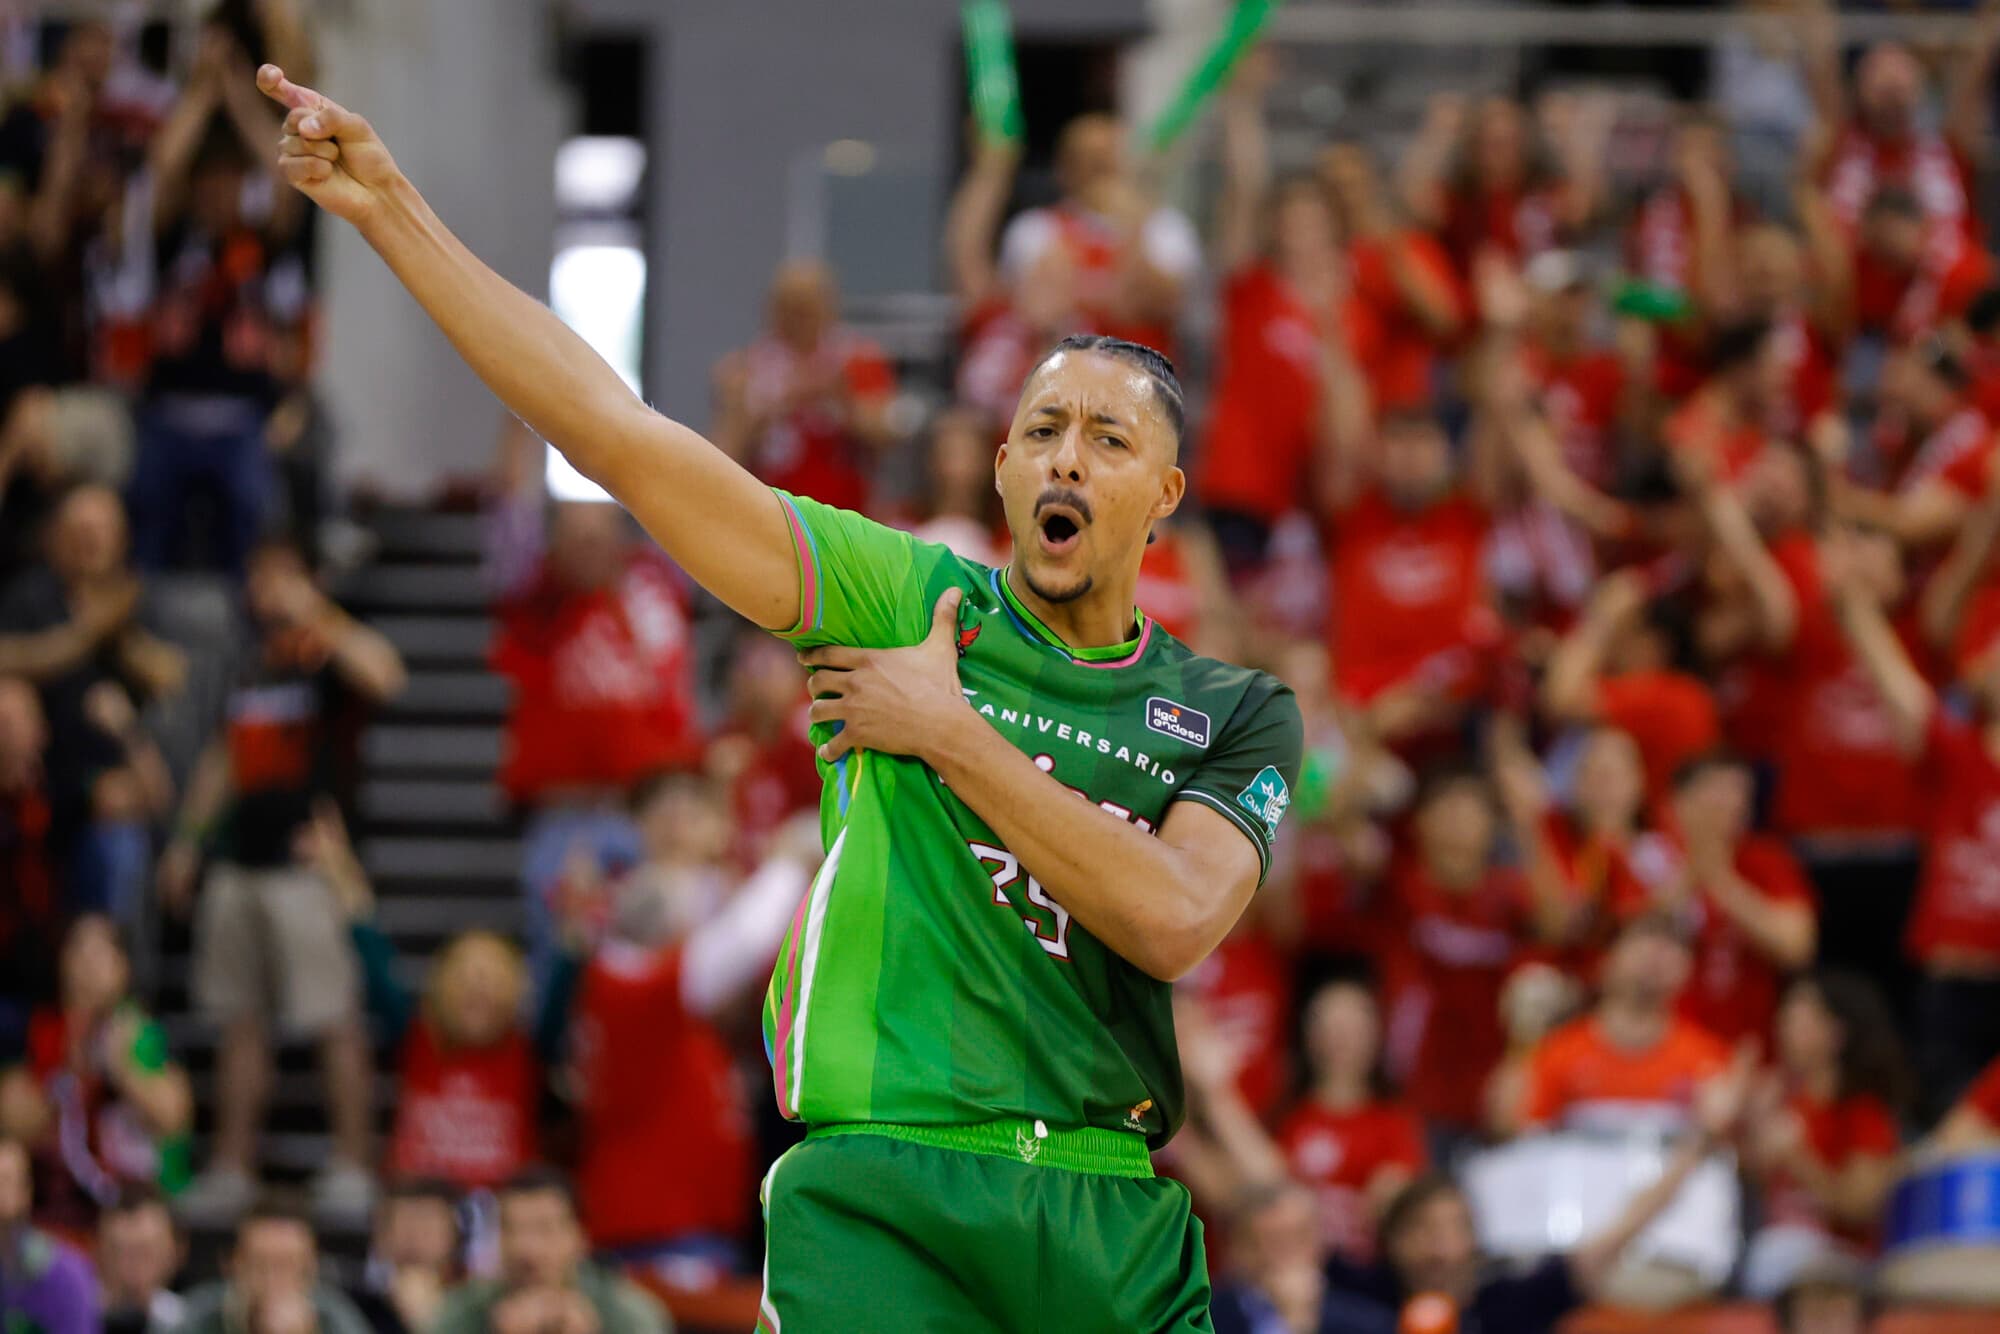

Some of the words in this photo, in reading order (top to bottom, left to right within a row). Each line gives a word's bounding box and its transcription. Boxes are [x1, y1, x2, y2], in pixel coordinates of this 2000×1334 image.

[1154, 707, 1178, 723] liga
[1153, 718, 1204, 743] endesa
[979, 704, 1176, 785] ANIVERSARIO
